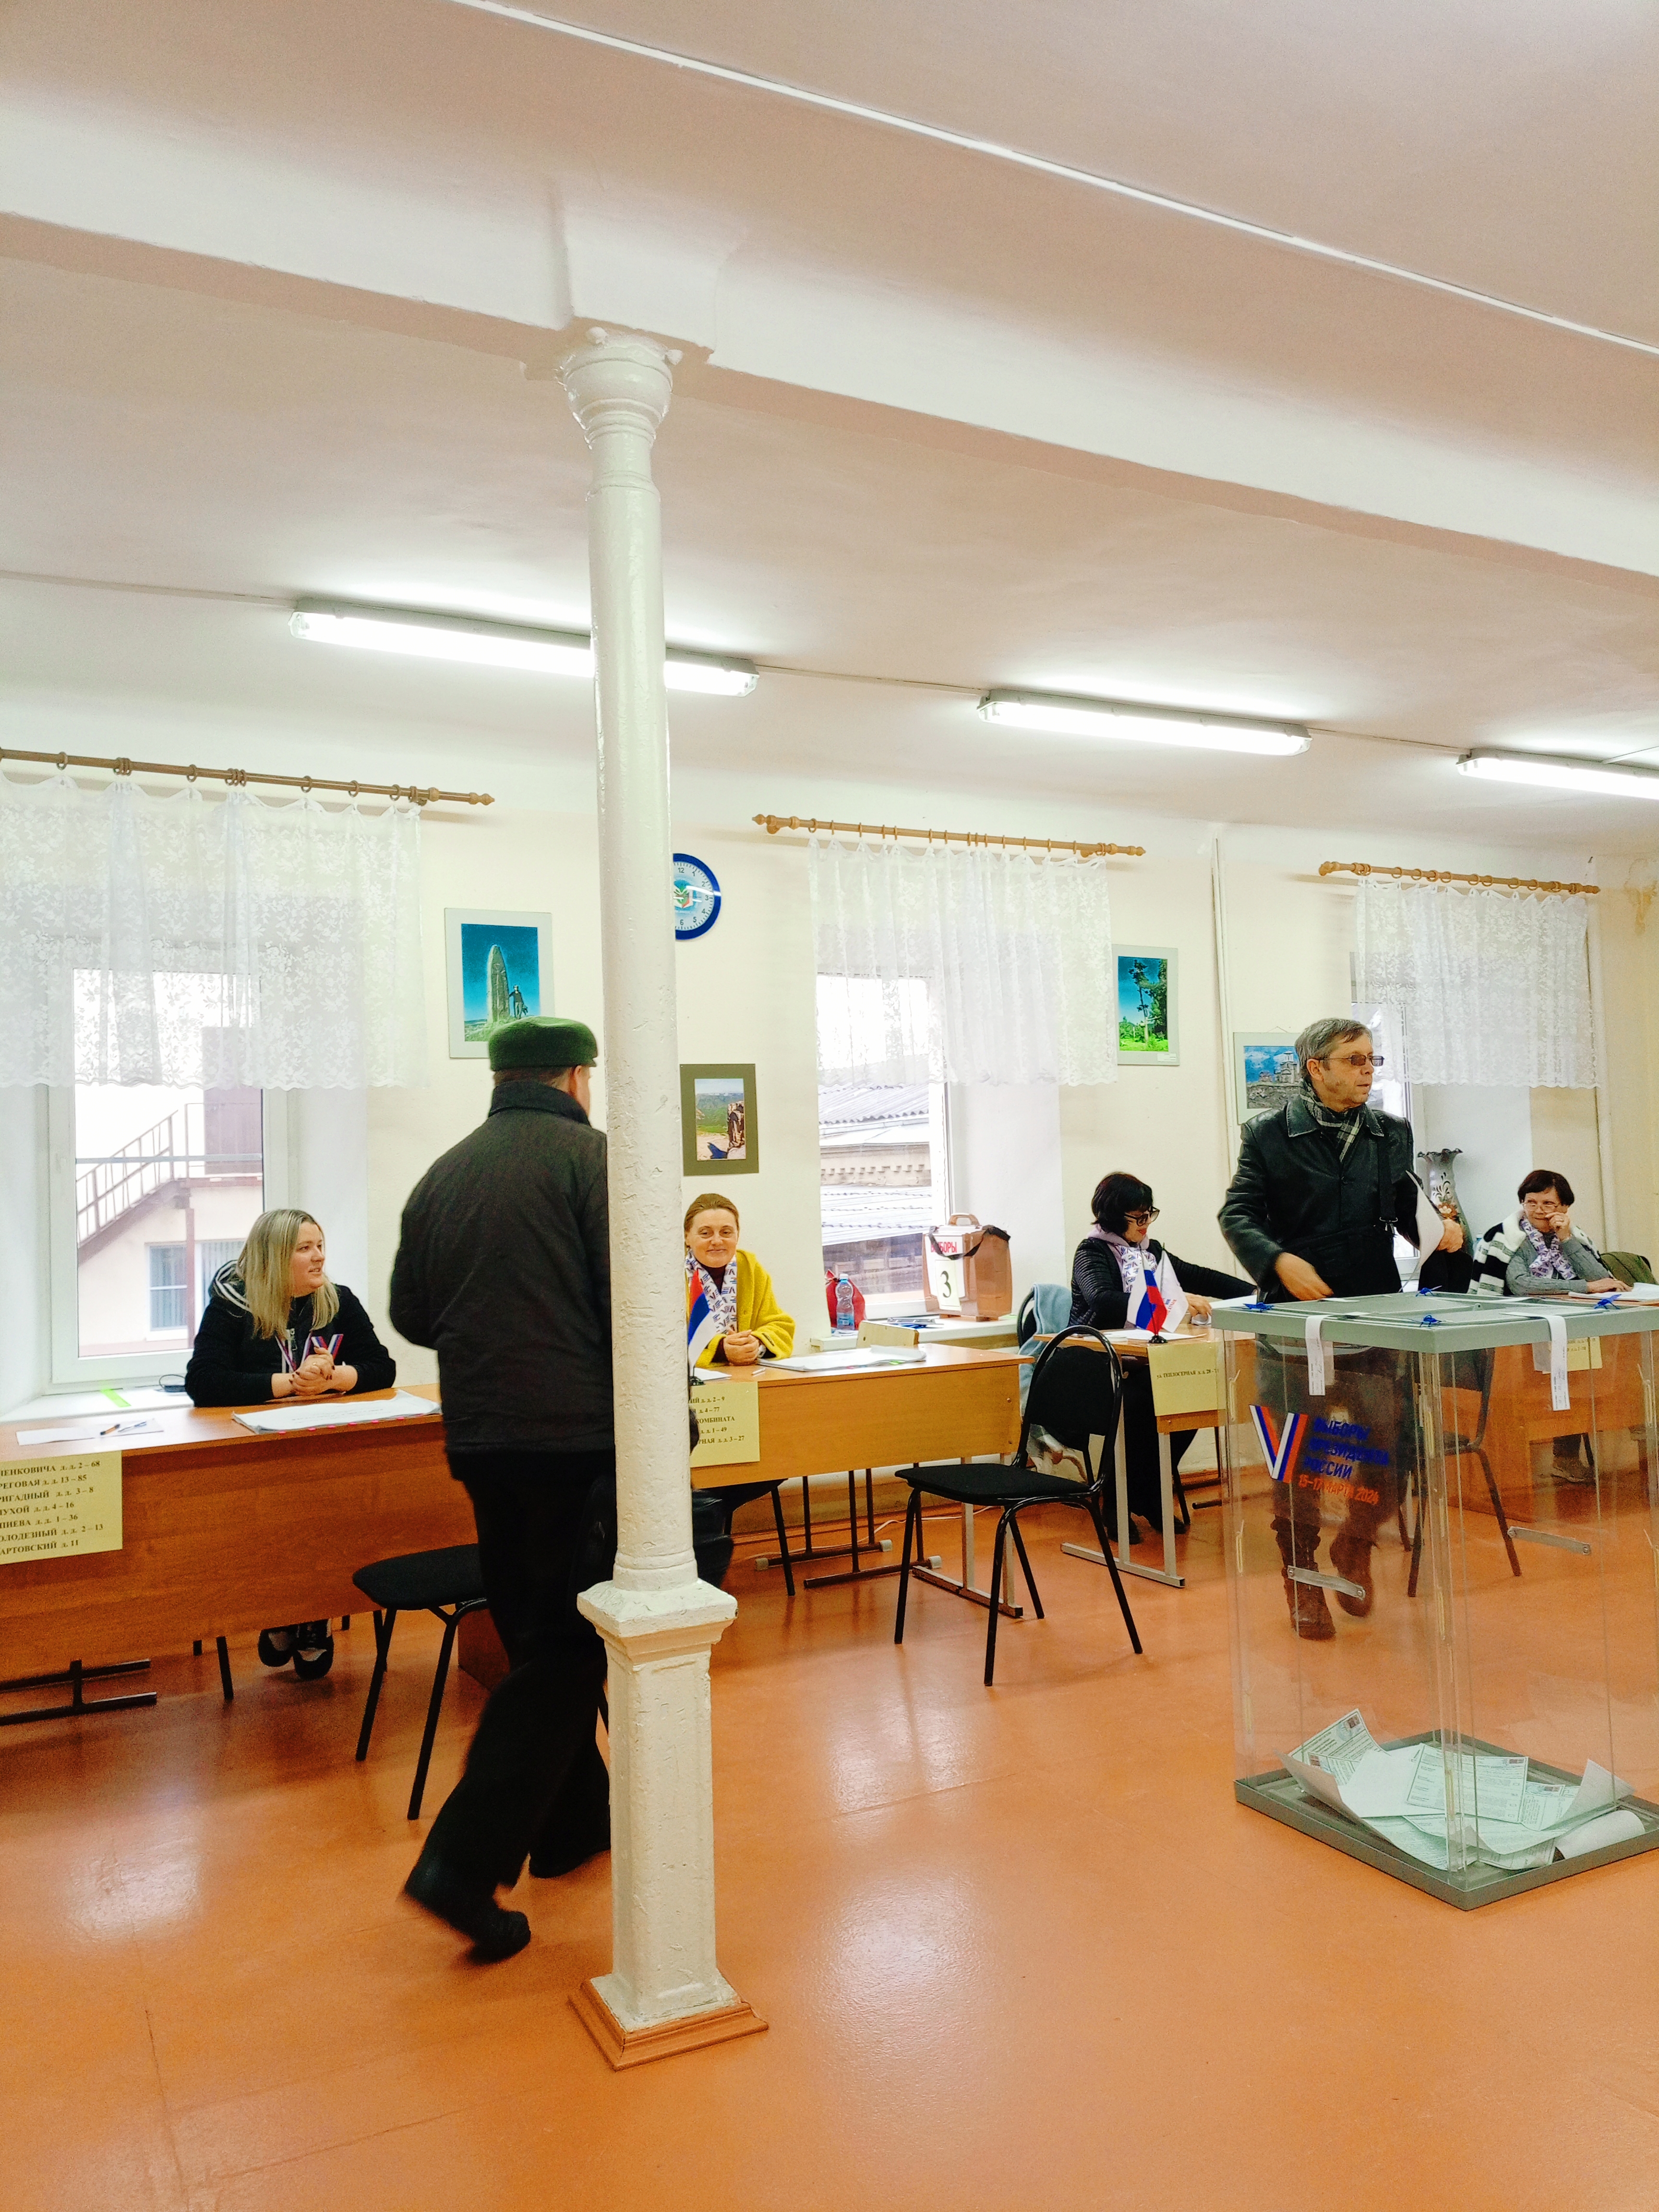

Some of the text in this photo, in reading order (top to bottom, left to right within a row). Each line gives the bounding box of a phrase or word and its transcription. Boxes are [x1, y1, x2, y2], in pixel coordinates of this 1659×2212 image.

[931, 1241, 957, 1253] ВБОРЫ
[940, 1271, 951, 1298] 3
[1303, 1456, 1353, 1479] РОССИИ
